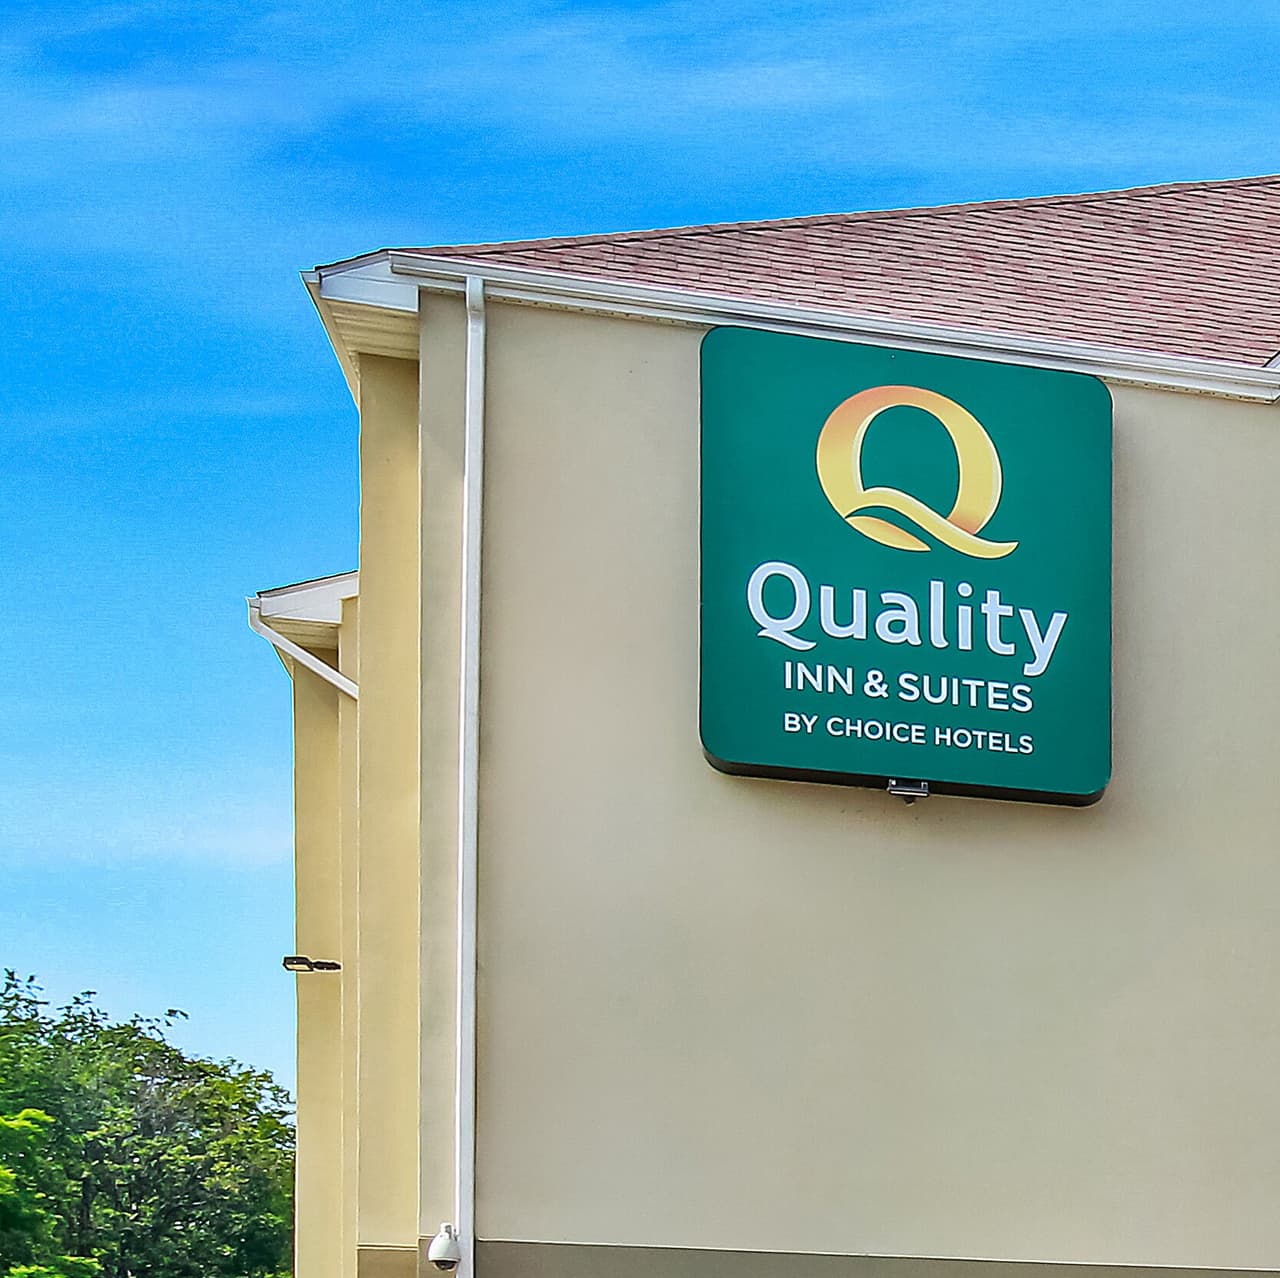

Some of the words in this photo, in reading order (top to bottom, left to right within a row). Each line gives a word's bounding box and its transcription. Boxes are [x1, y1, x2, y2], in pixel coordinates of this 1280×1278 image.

[816, 385, 1018, 559] Q
[747, 561, 1068, 675] Quality
[784, 661, 854, 695] INN
[863, 669, 889, 698] &
[898, 673, 1033, 712] SUITES
[784, 713, 818, 733] BY
[826, 717, 926, 744] CHOICE
[934, 727, 1033, 754] HOTELS
